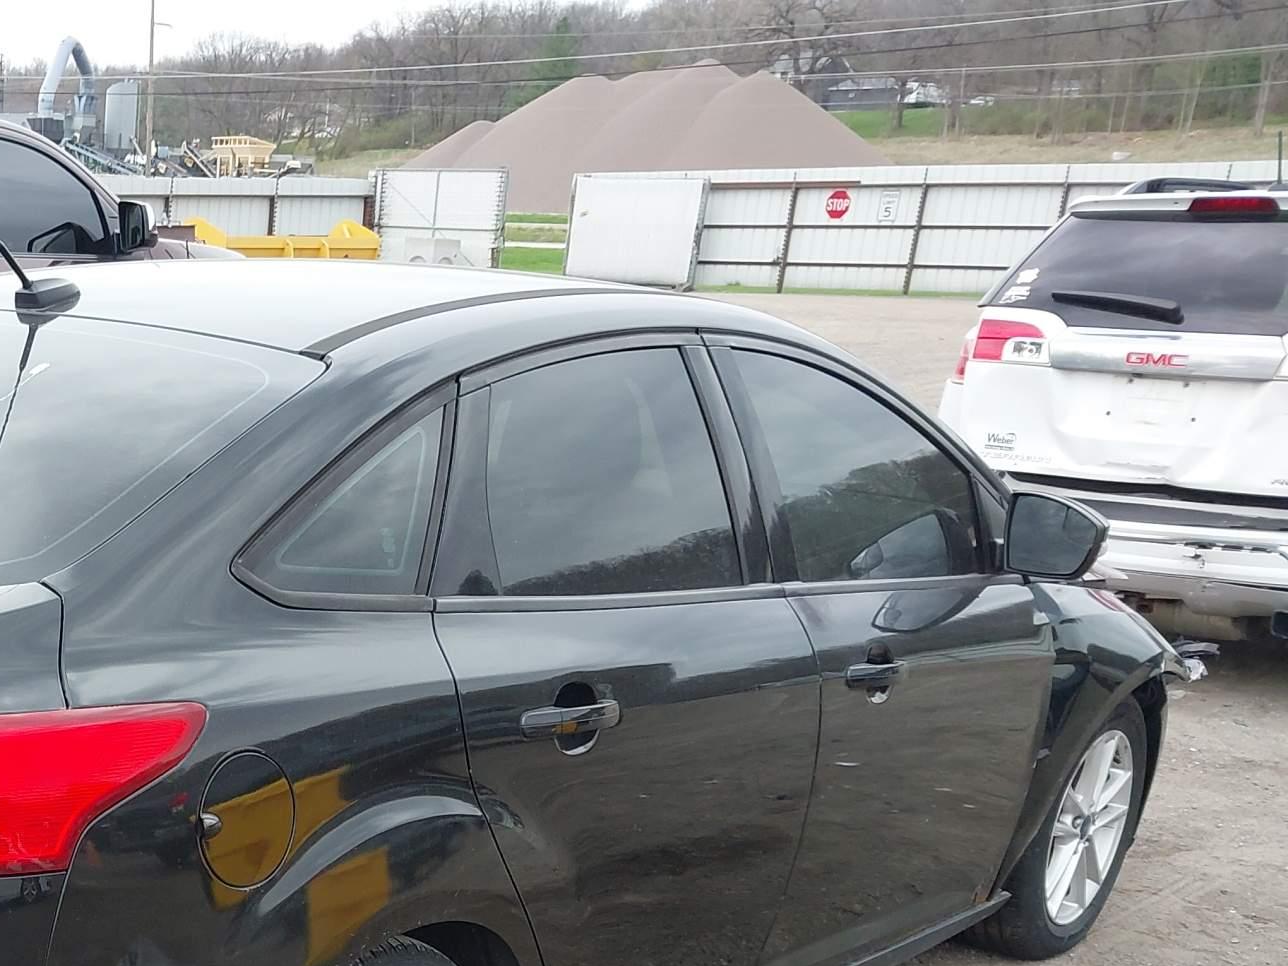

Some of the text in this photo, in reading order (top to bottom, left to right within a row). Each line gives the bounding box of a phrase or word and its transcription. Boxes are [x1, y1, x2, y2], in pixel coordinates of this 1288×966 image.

[826, 198, 850, 211] STOP
[883, 206, 893, 218] 5
[1126, 352, 1189, 368] GMC
